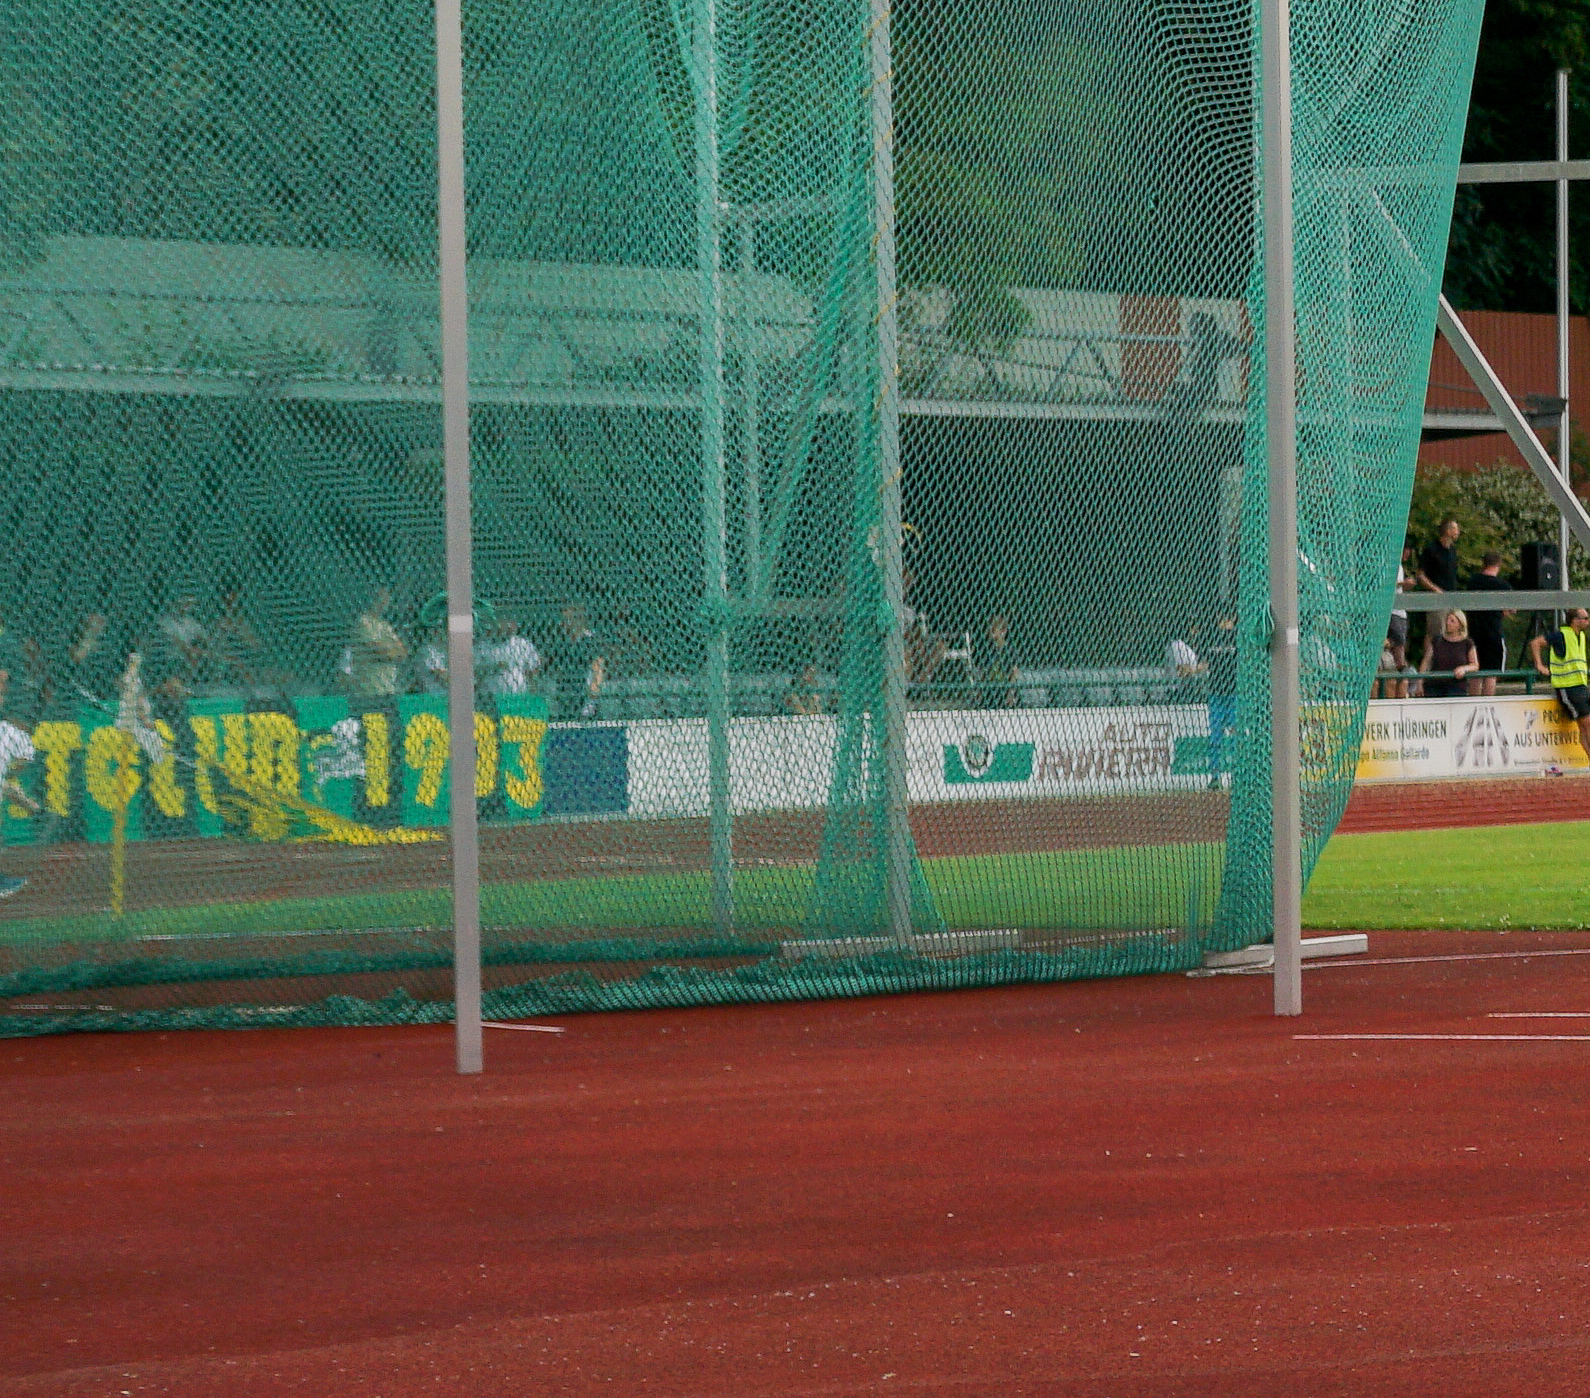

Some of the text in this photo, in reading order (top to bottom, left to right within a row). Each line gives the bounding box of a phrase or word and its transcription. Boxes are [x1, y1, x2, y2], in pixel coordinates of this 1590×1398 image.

[1393, 717, 1446, 739] THÜRINGEN
[1514, 731, 1532, 747] AUS
[362, 712, 547, 808] 1903
